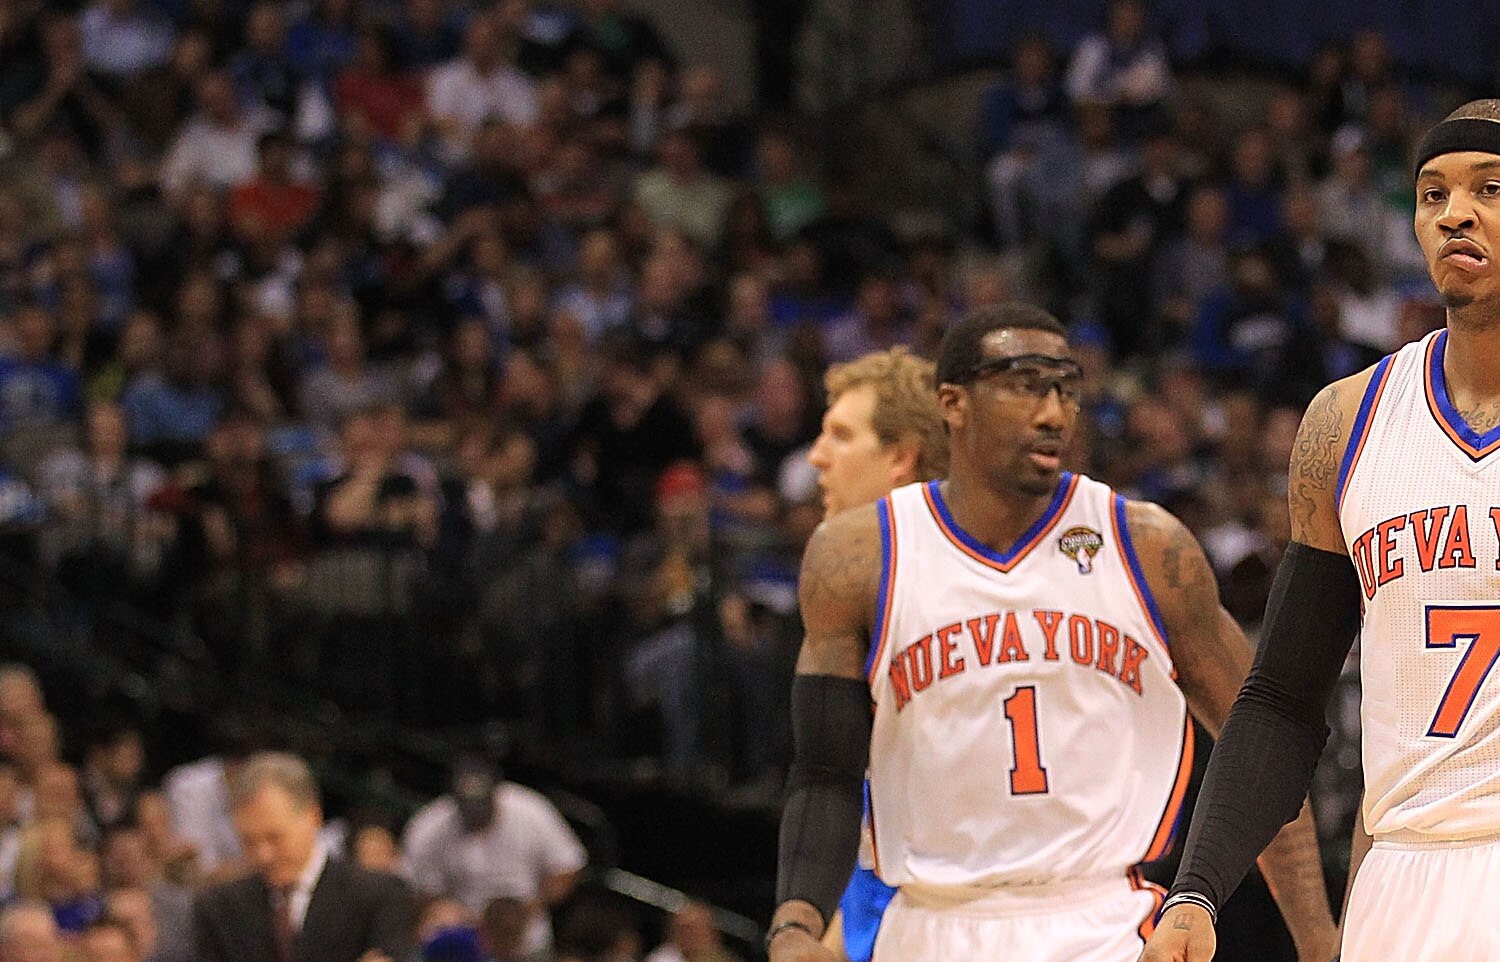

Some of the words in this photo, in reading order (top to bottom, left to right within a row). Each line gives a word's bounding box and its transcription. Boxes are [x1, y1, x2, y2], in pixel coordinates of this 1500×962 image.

[1353, 505, 1476, 601] UEVA
[889, 611, 1029, 713] NUEVA
[1034, 611, 1149, 696] YORK
[1004, 686, 1048, 795] 1
